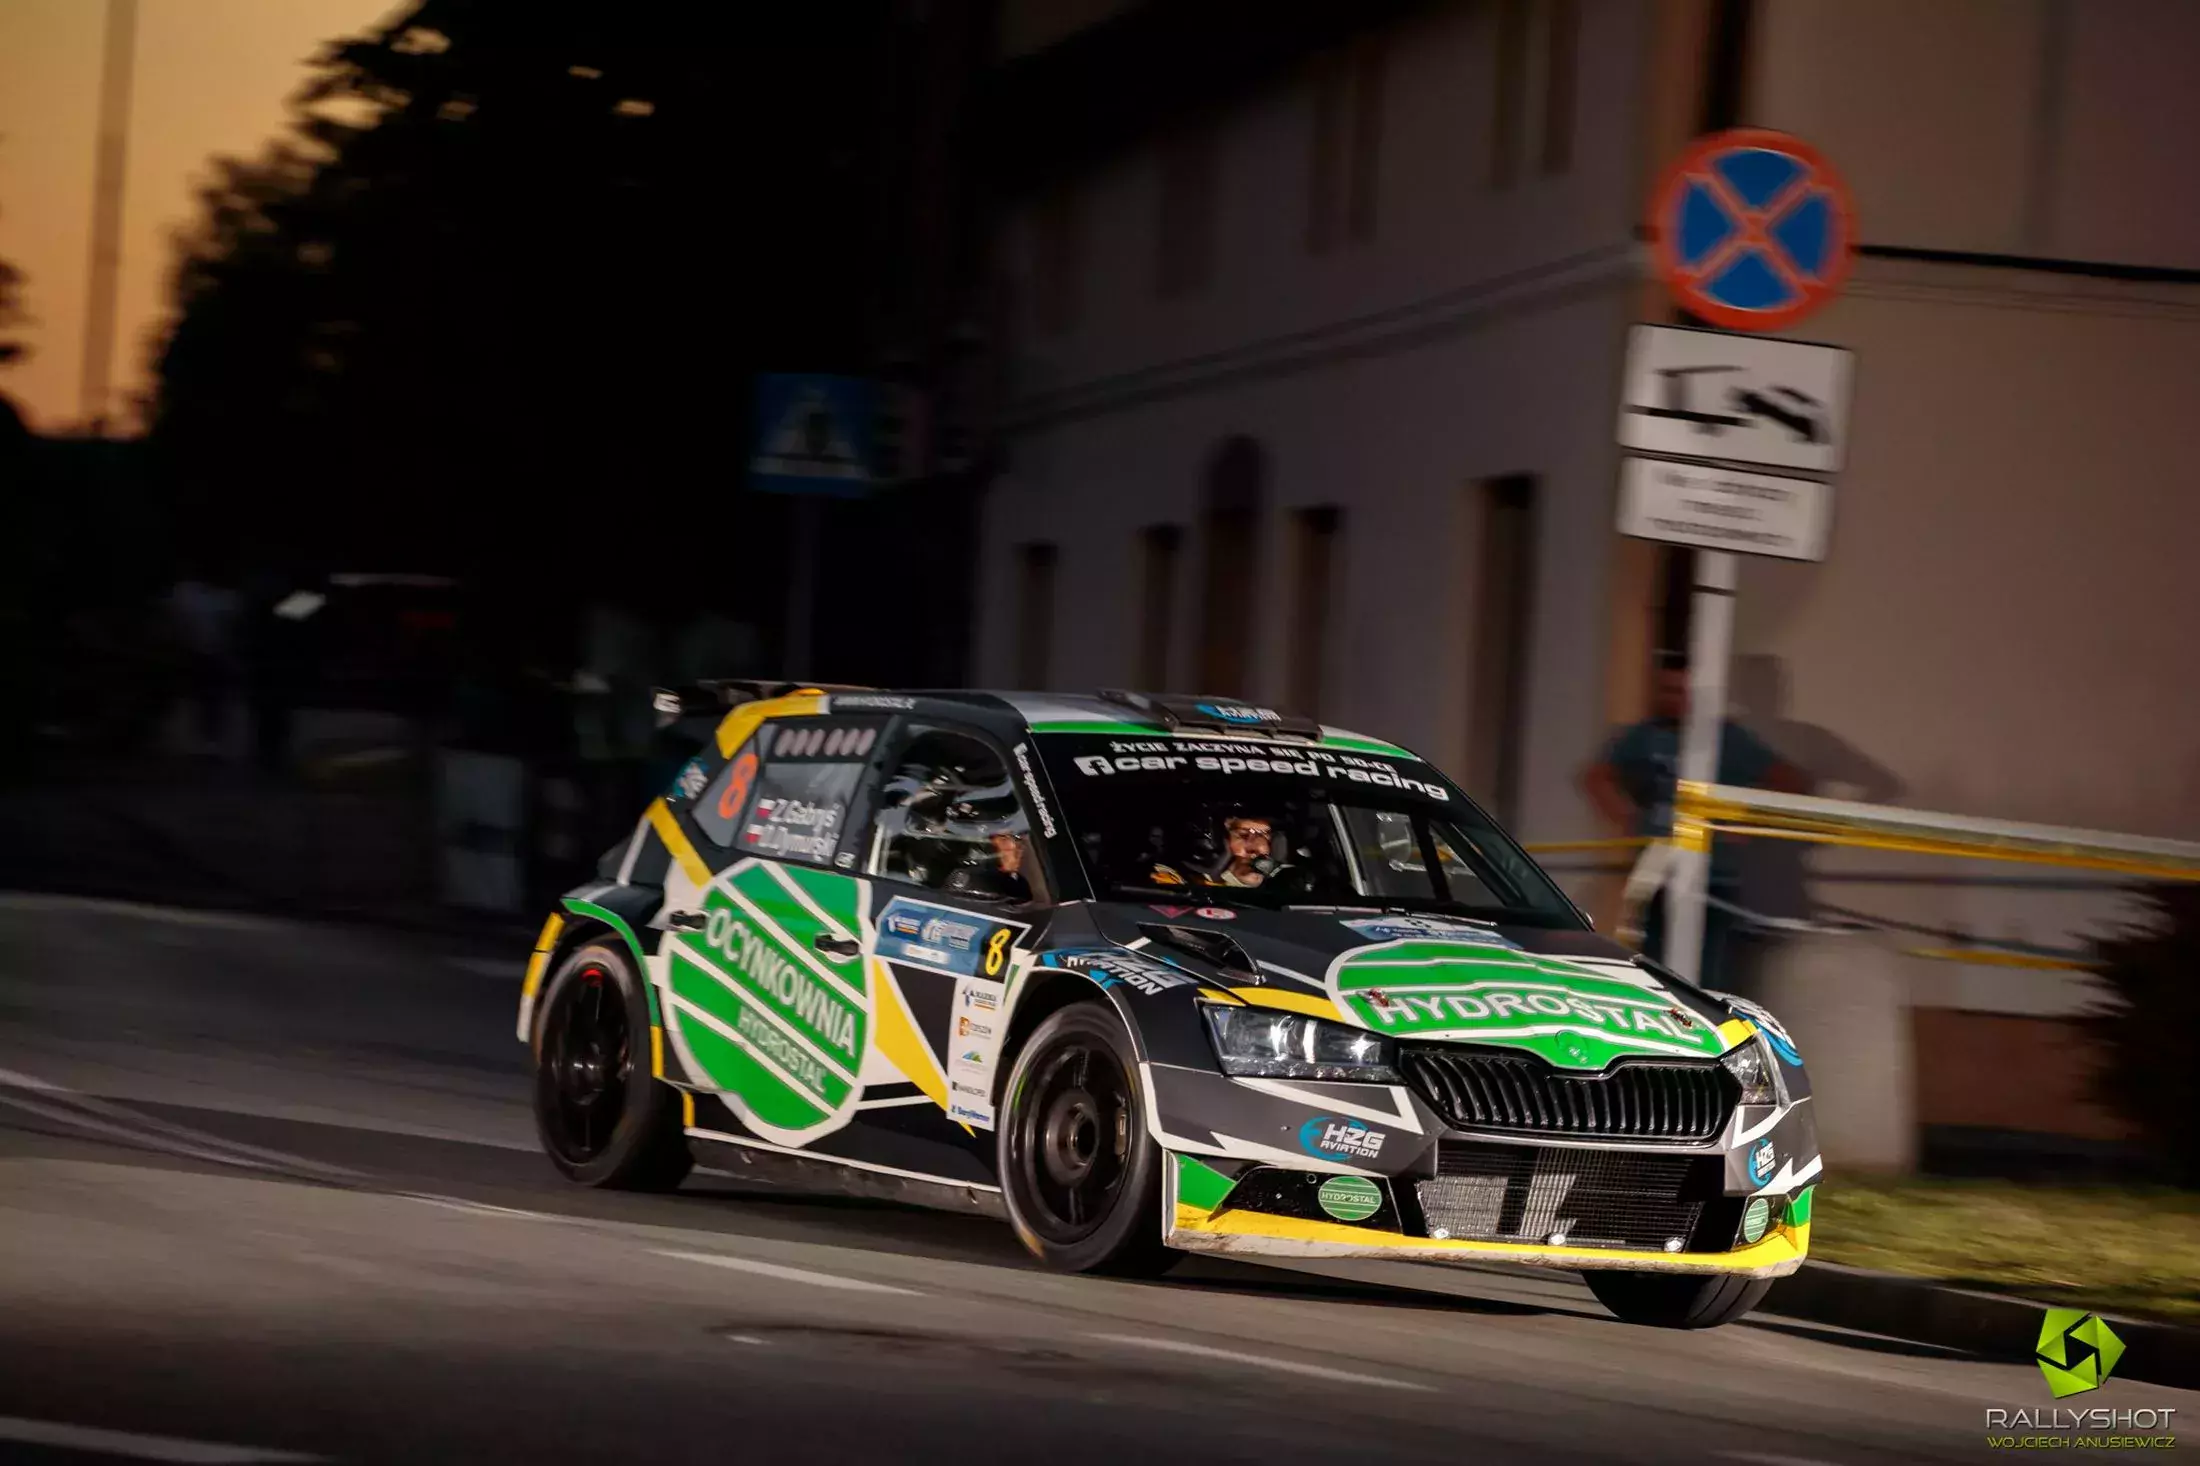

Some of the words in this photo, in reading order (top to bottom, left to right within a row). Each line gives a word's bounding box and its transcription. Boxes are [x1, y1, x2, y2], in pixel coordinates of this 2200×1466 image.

[1172, 742, 1266, 756] ZACZYNA
[718, 752, 757, 819] 8
[1114, 756, 1188, 771] car
[1195, 757, 1320, 777] speed
[1326, 765, 1450, 801] racing
[985, 928, 1011, 976] 8
[705, 908, 856, 1058] OCYNKOWNIA
[1380, 992, 1702, 1044] HYDROSTAL
[1320, 1140, 1379, 1158] AVIATION
